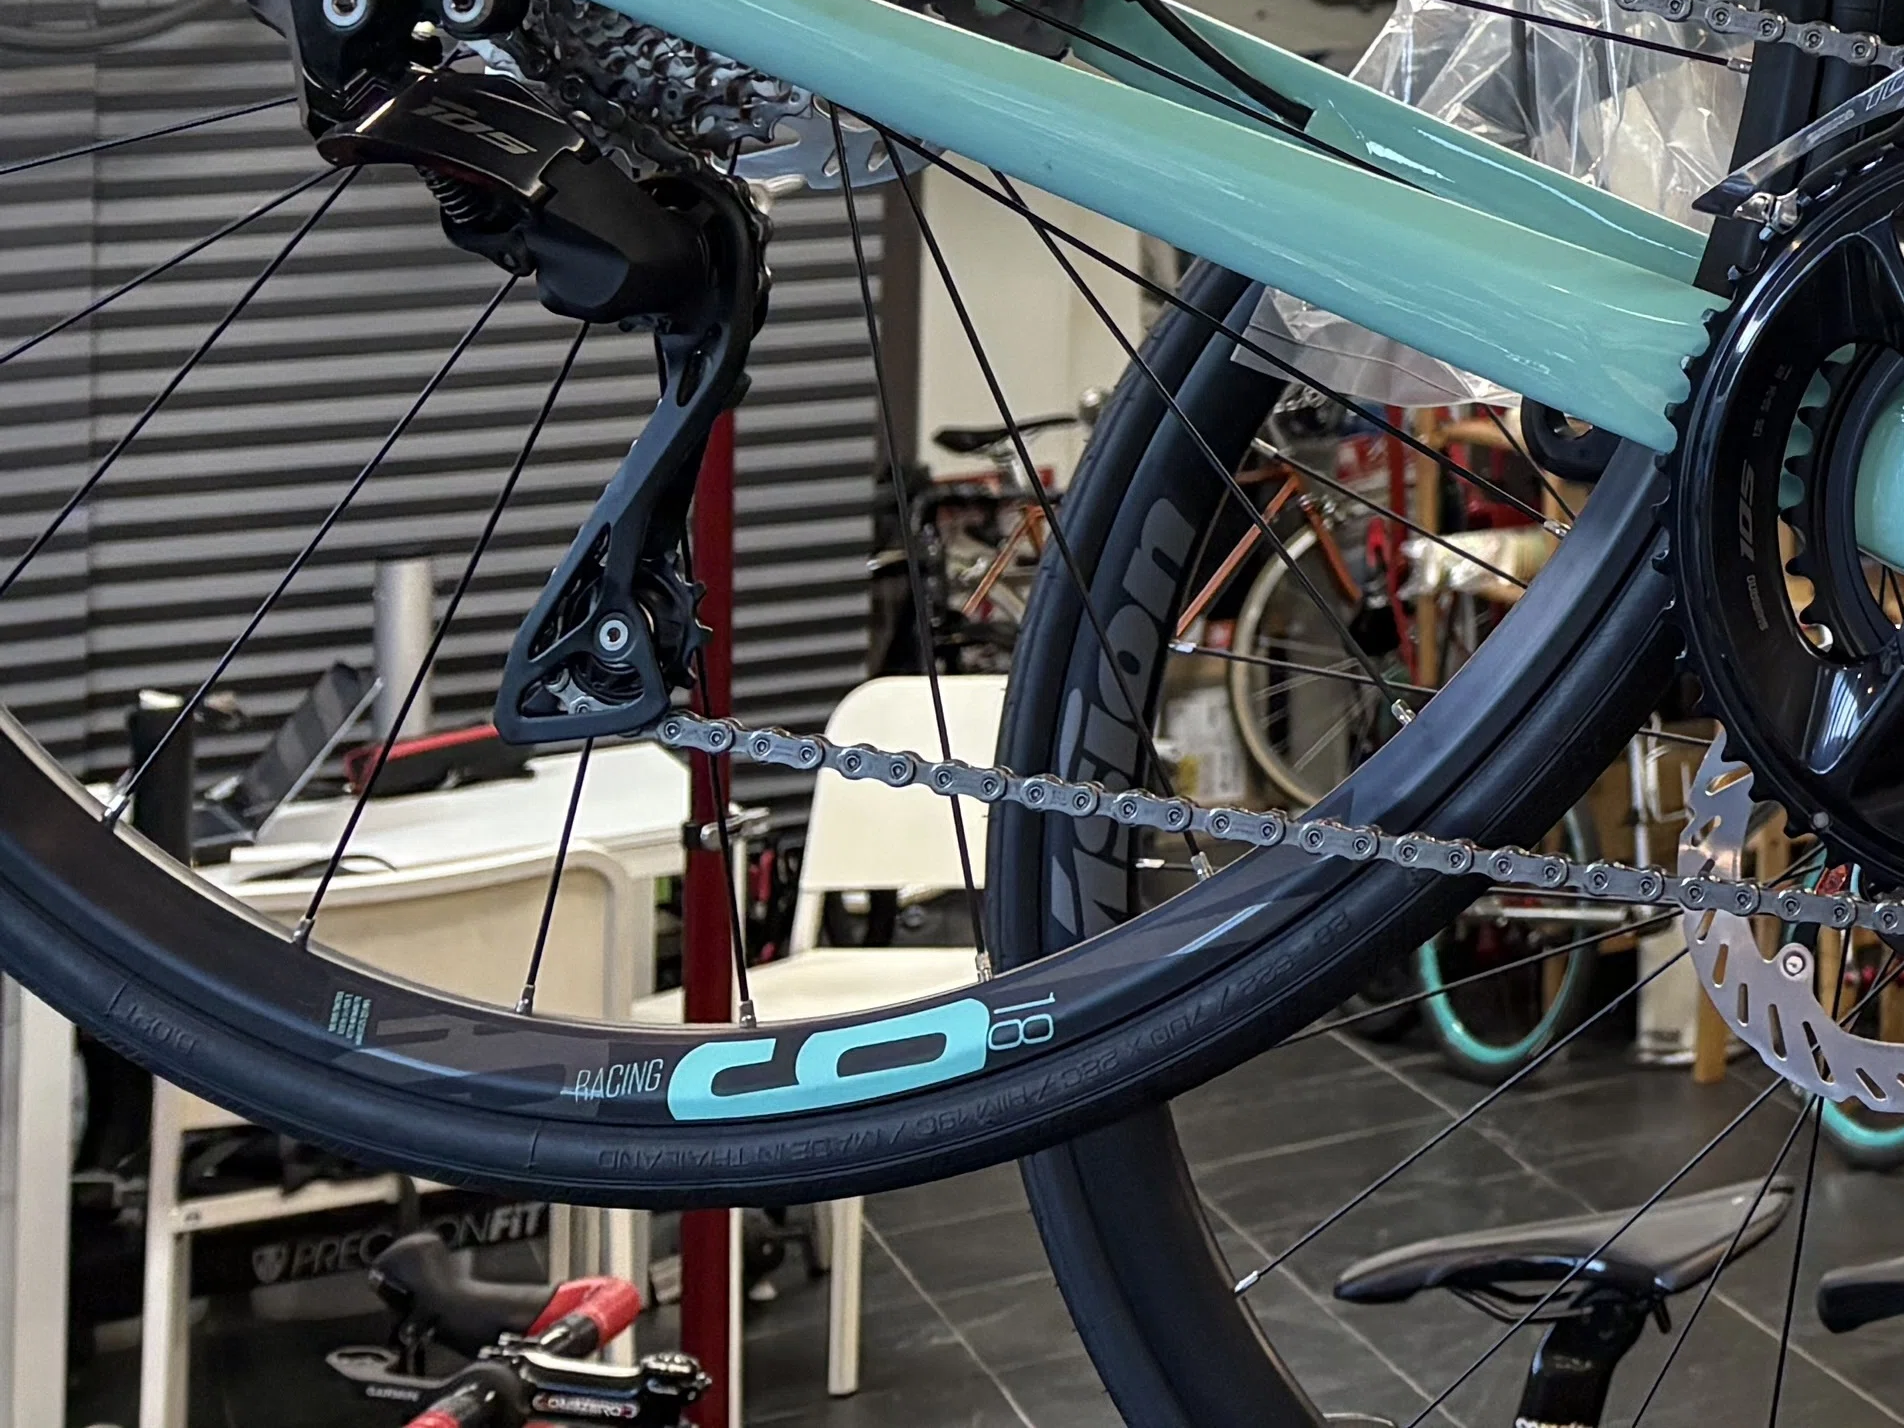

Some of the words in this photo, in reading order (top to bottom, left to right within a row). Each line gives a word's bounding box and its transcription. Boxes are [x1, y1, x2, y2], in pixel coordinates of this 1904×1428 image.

[410, 95, 539, 155] 105
[1737, 460, 1758, 563] 105
[987, 990, 1058, 1052] 18
[573, 1056, 666, 1104] RACING
[597, 1148, 748, 1170] THAILAND
